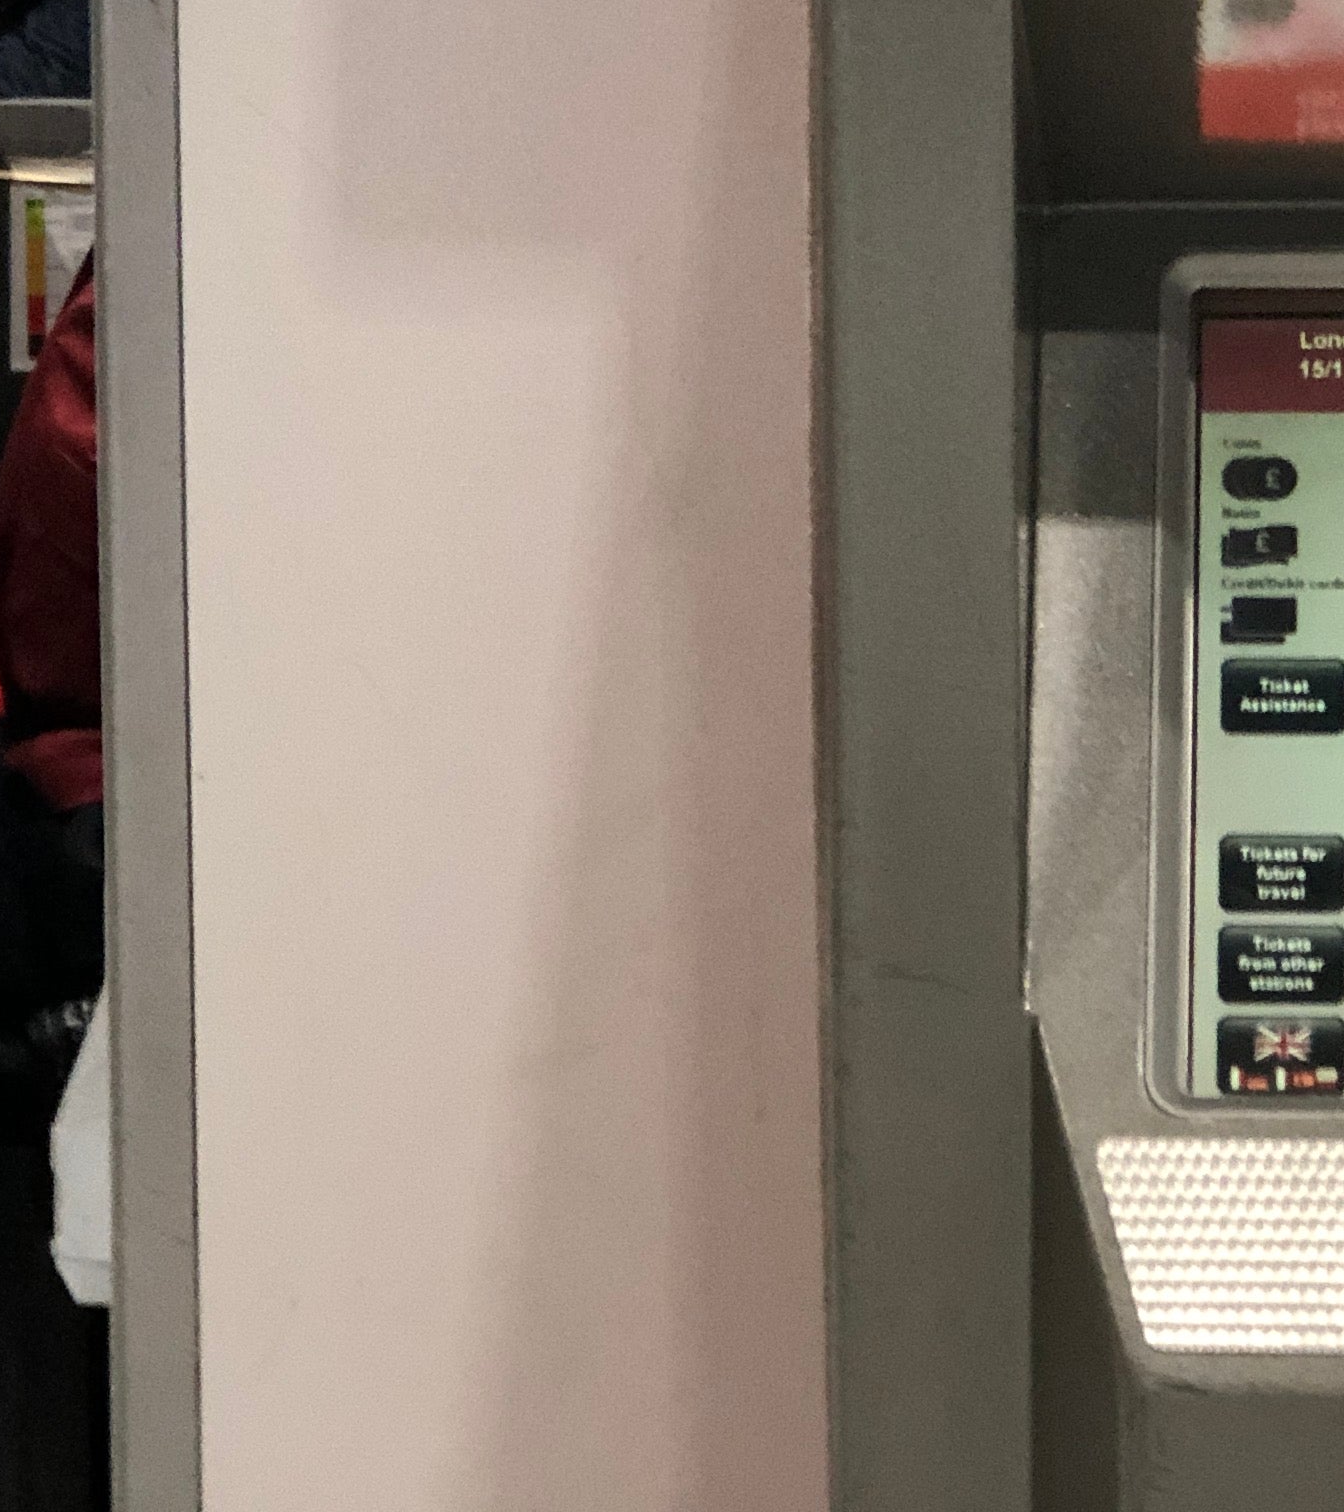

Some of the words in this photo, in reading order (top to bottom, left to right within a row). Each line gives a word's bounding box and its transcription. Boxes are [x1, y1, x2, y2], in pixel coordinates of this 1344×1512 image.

[1258, 677, 1309, 694] Ticket
[1240, 696, 1326, 714] Assistance
[1256, 865, 1306, 881] future
[1256, 885, 1306, 901] travel
